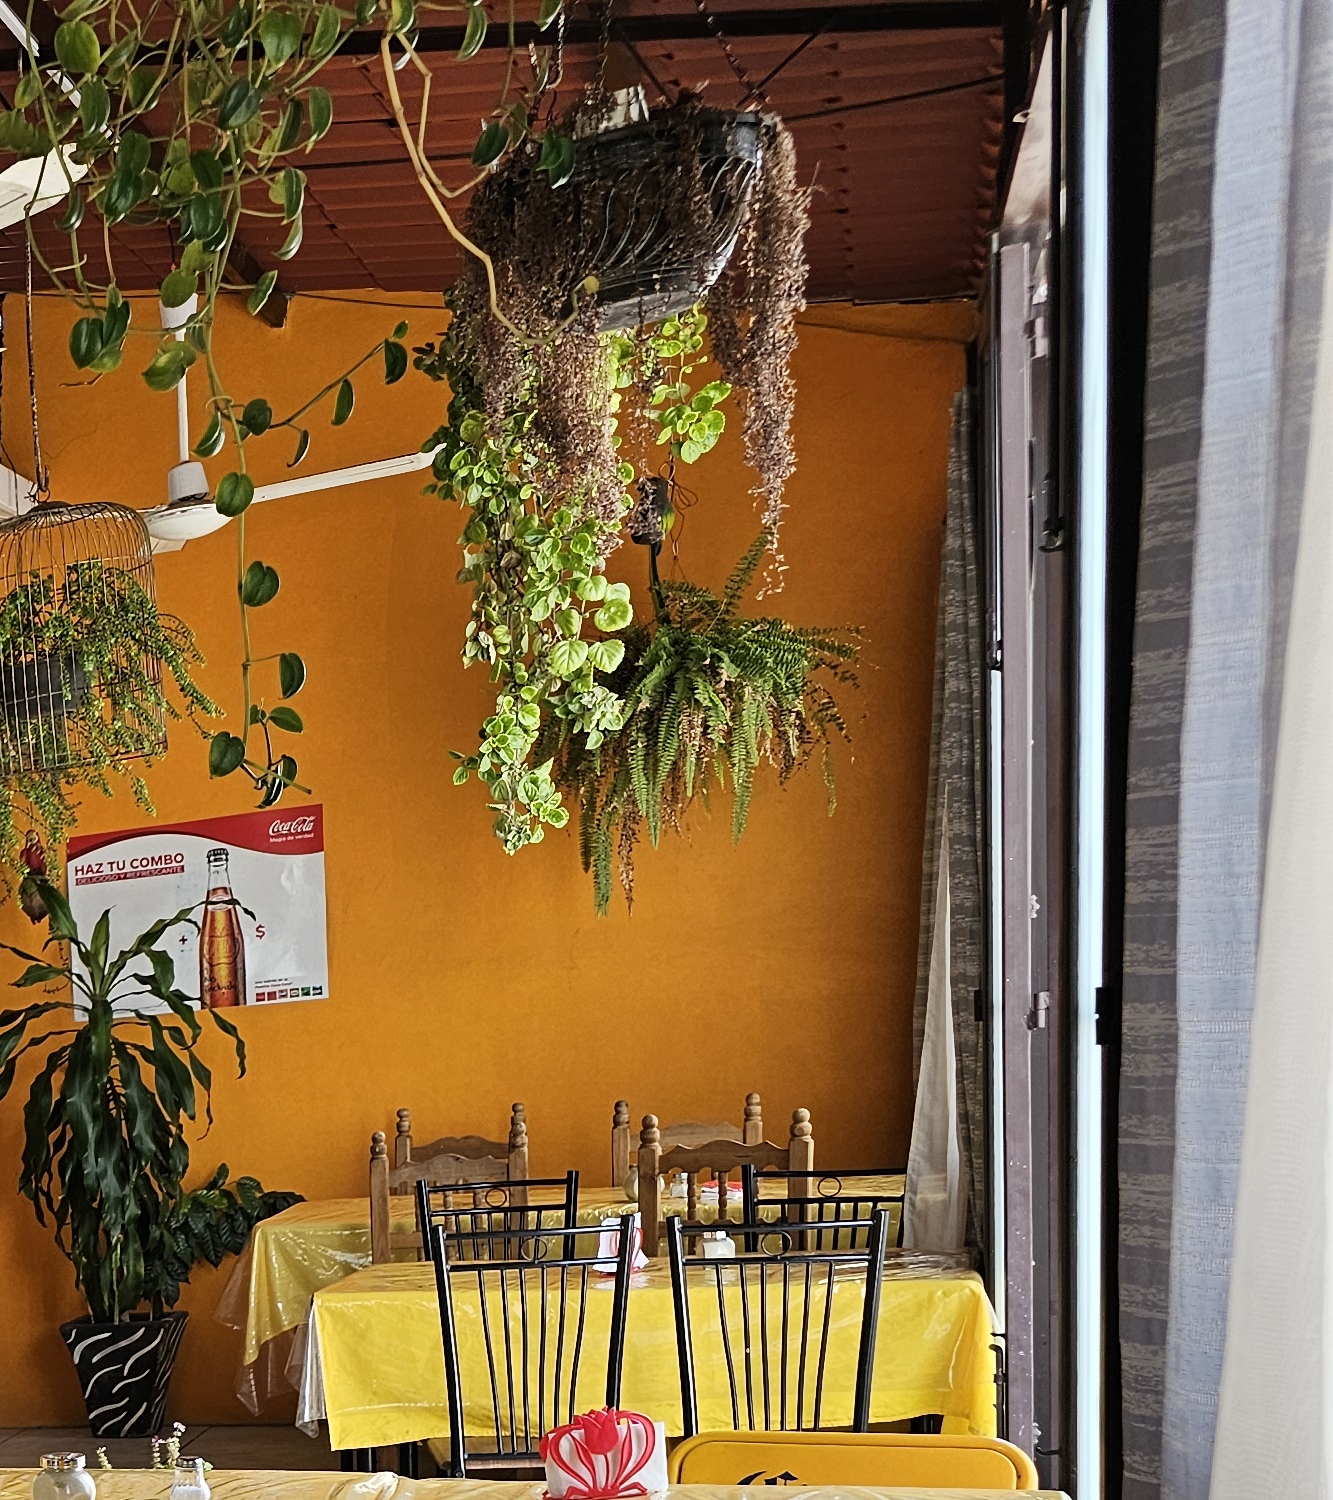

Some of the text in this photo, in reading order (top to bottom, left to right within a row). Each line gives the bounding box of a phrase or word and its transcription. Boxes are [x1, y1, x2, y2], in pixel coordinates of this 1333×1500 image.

[269, 815, 316, 836] Coca-Cola
[75, 852, 184, 876] HAZ TU COMBO
[77, 873, 118, 885] DELICIOSO
[126, 866, 183, 879] REFRESCANTE
